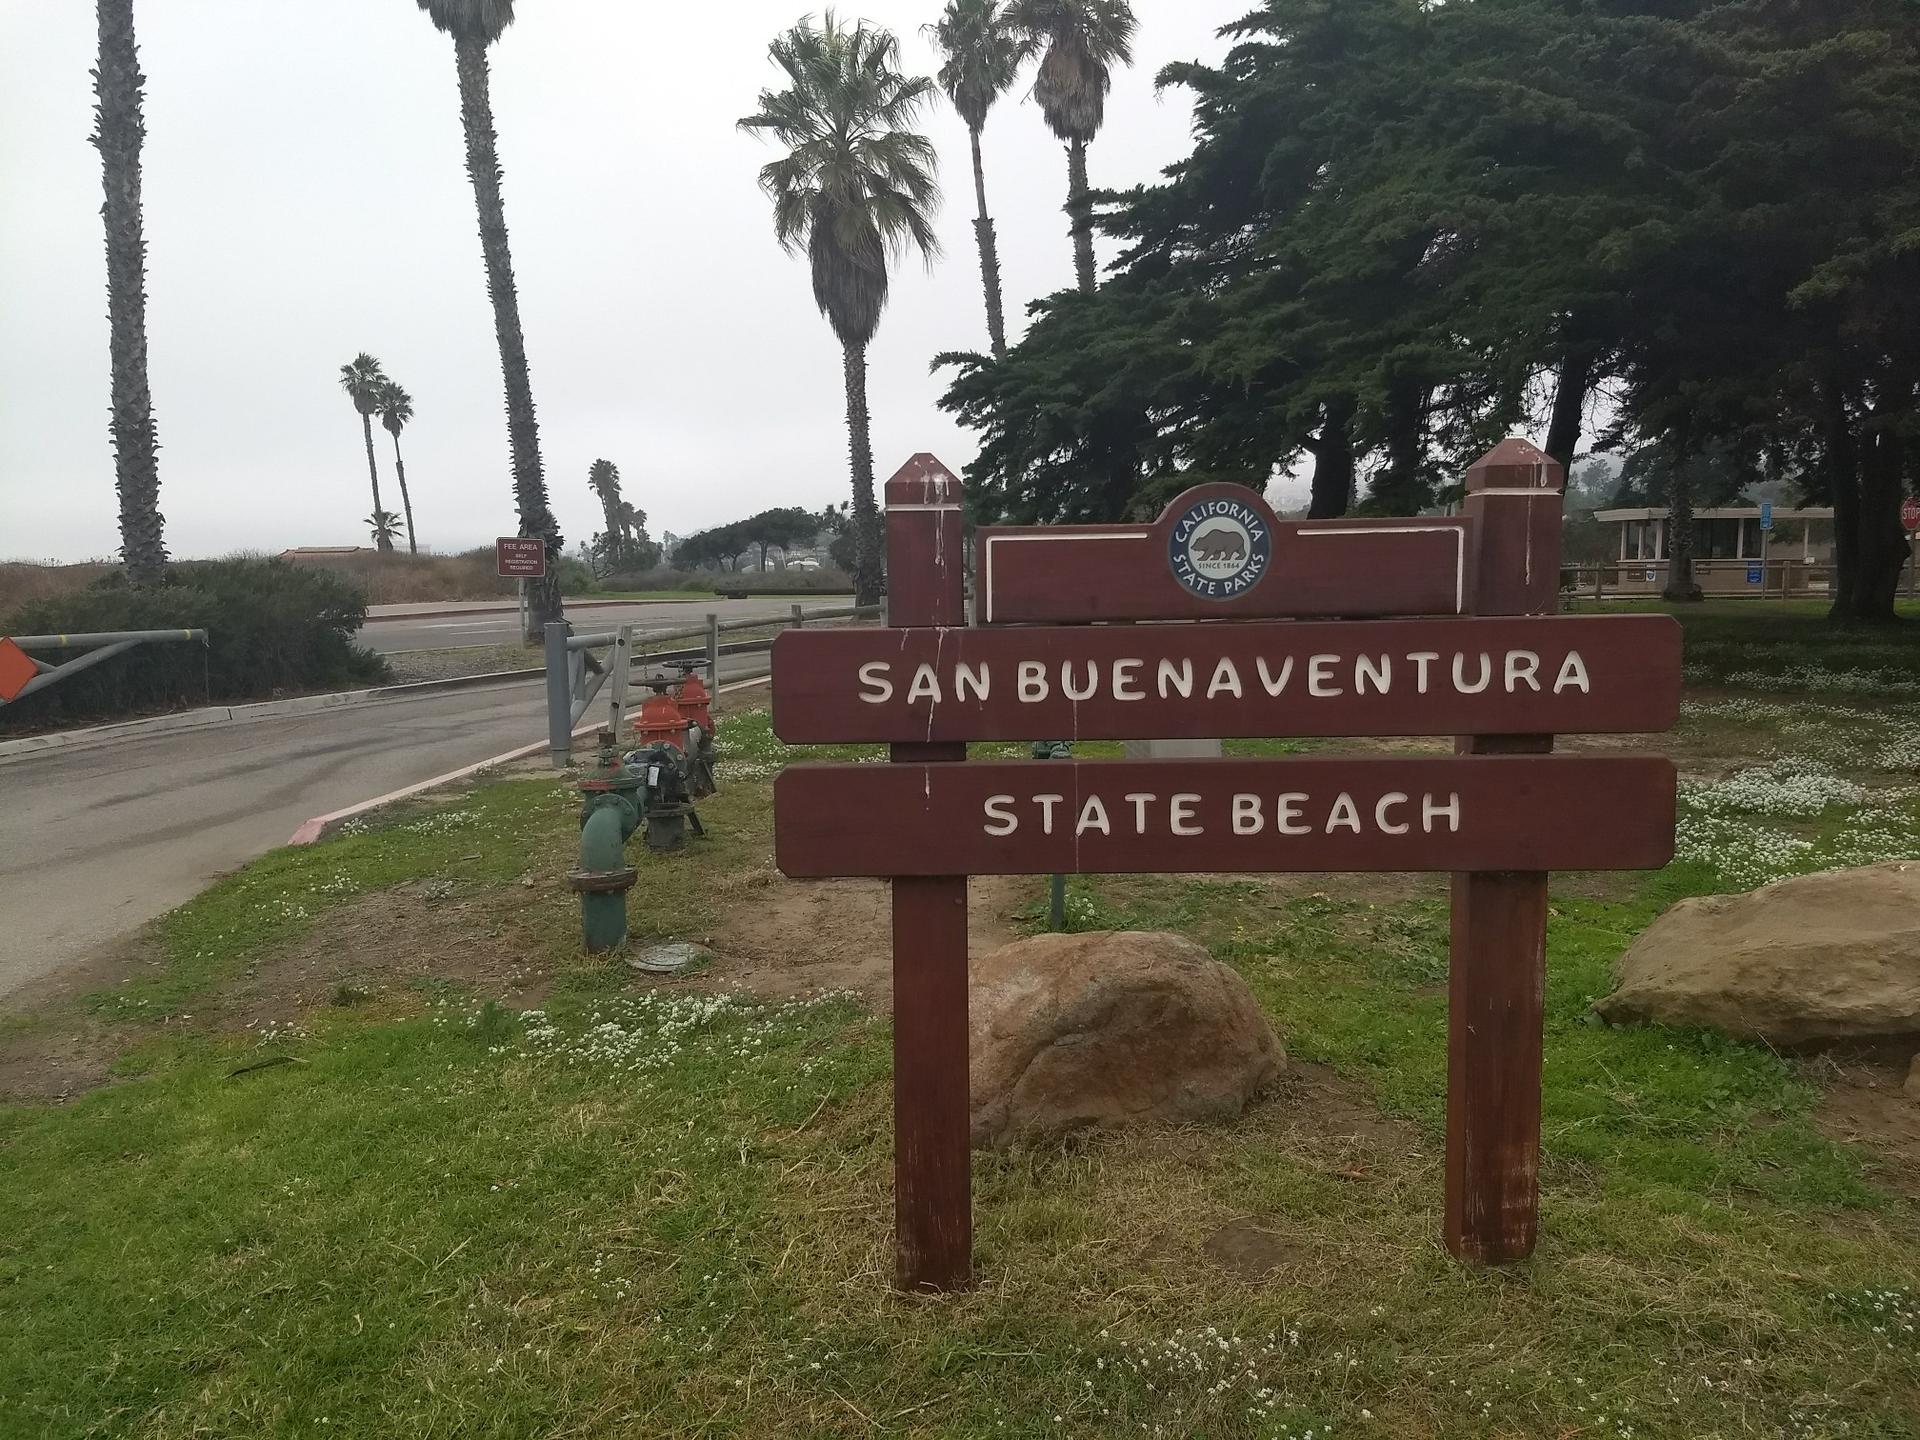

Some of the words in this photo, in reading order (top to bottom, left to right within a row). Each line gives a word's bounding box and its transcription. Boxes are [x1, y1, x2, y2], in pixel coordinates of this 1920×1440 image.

[1175, 501, 1264, 543] CALIFORNIA
[1173, 554, 1216, 595] STATE
[1224, 553, 1264, 594] PARKS
[858, 660, 991, 705] SAN
[1017, 650, 1590, 703] BUENAVENTURA
[983, 793, 1205, 836] STATE
[1231, 792, 1461, 836] BEACH
